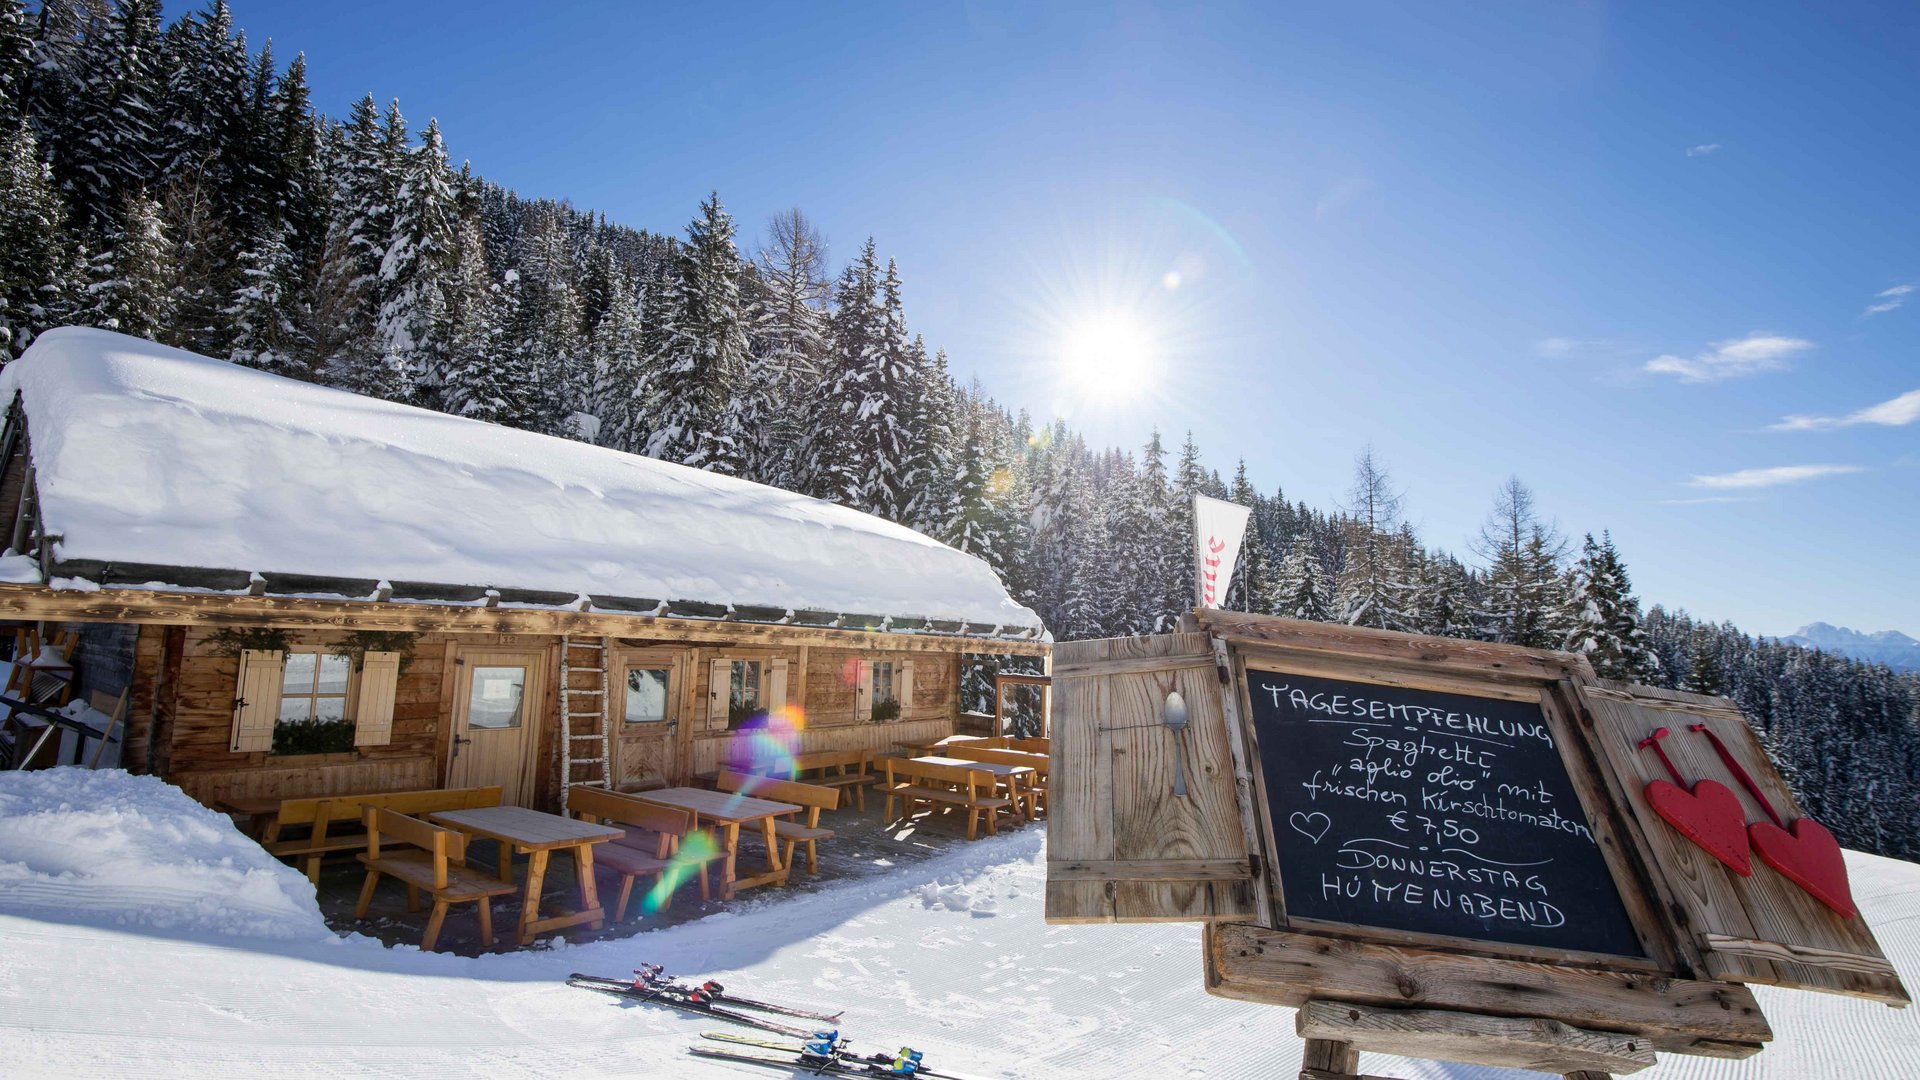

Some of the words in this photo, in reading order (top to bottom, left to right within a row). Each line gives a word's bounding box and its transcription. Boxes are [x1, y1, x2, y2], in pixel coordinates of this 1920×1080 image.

[1261, 683, 1553, 749] TAGESEMPFEHLUNG
[1343, 728, 1497, 769] Spaghetti
[1302, 770, 1407, 806] frischen
[1422, 787, 1595, 844] Kirschtomaten
[1498, 780, 1554, 803] mit
[1415, 814, 1480, 845] 7,50
[1336, 849, 1548, 896] DONNERSTAG
